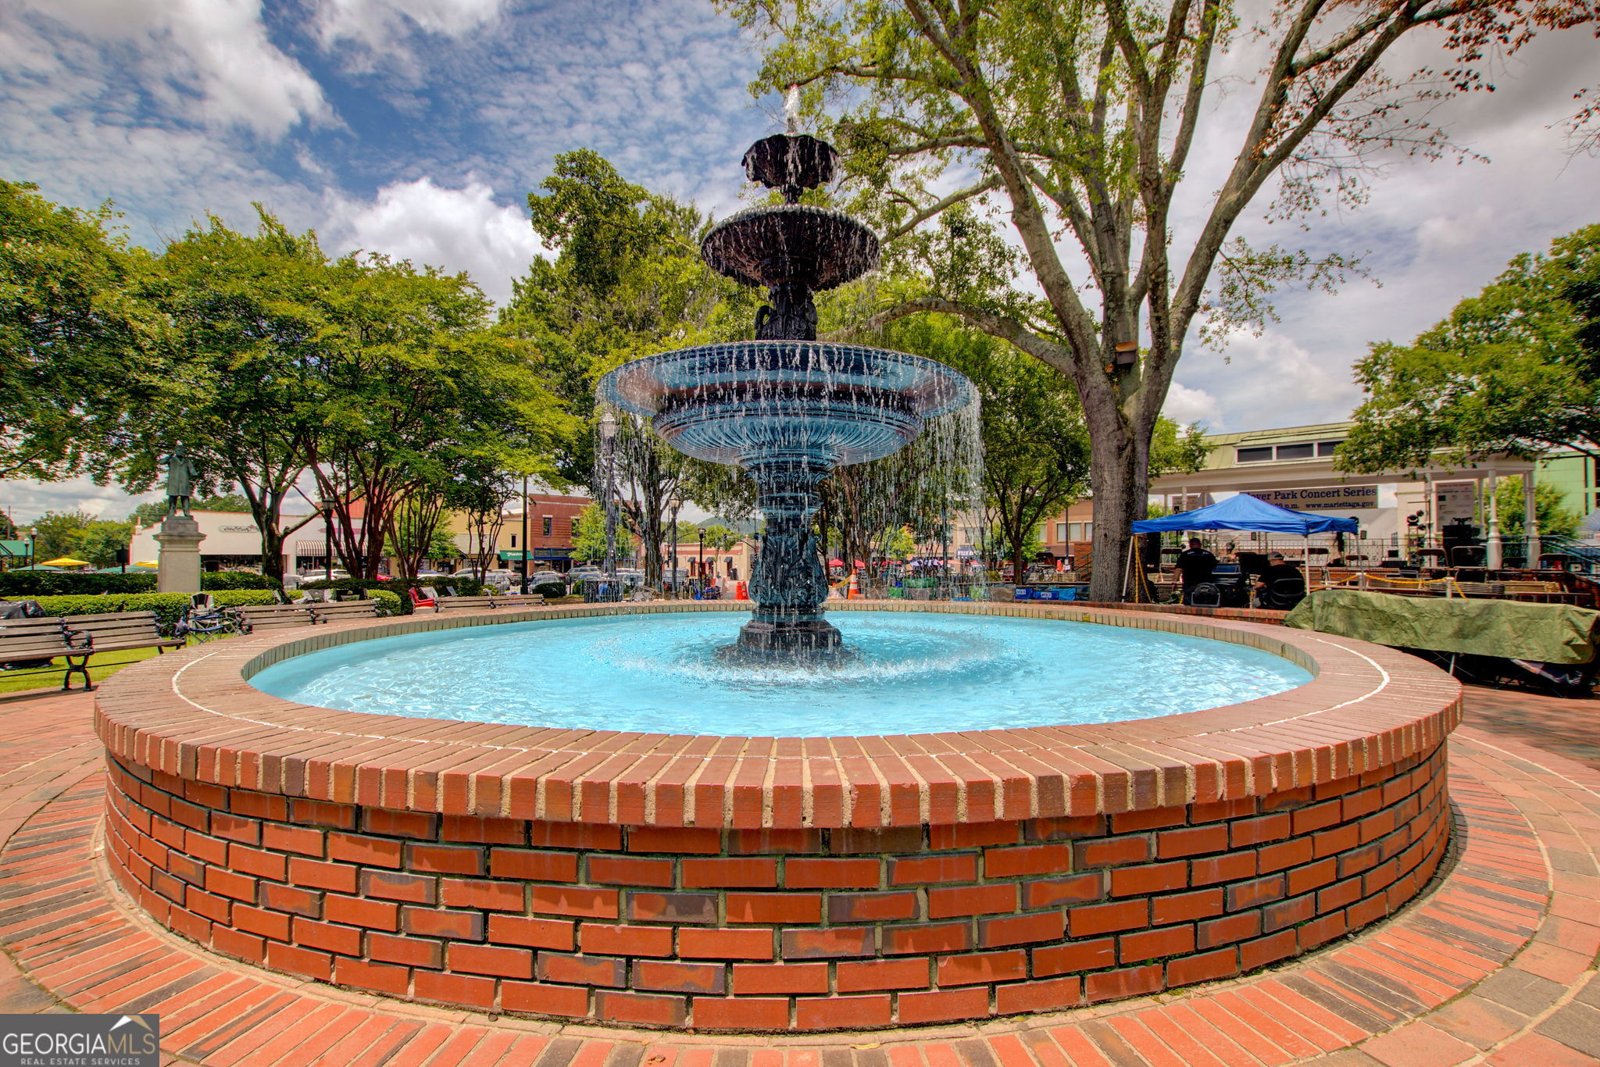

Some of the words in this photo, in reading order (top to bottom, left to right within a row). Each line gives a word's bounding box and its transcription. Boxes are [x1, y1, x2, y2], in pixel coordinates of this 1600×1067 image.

[1274, 490, 1298, 500] Park
[1300, 488, 1340, 499] Concert
[1343, 487, 1377, 497] Series
